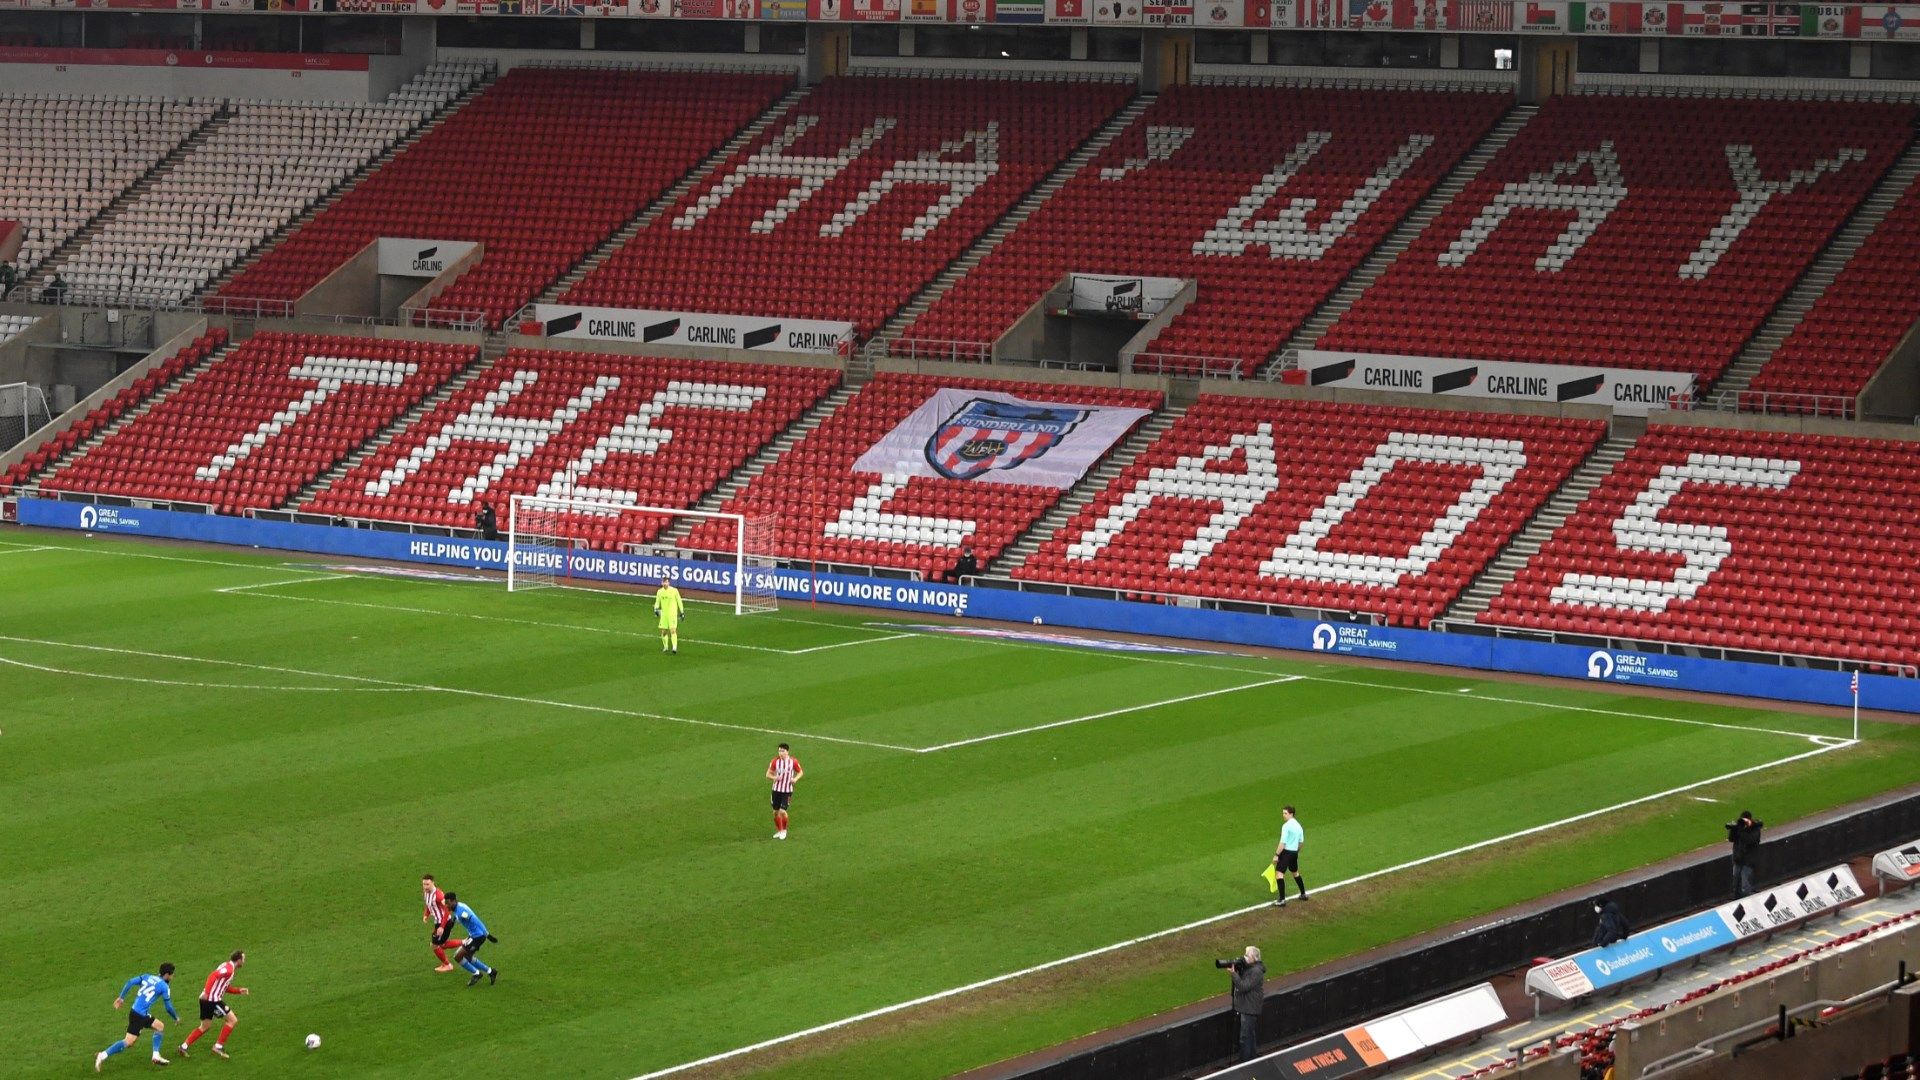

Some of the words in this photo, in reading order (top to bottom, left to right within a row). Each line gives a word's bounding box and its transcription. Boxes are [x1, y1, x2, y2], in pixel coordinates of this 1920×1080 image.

[381, 3, 411, 11] BRANCH
[1809, 7, 1852, 16] DUBLIN
[1149, 14, 1188, 24] BRANCH
[1689, 26, 1736, 34] YORKIRE
[412, 259, 443, 272] CARLING
[588, 319, 636, 338] CARLING
[687, 325, 737, 345] CARLING
[1364, 367, 1423, 389] CARLING
[1487, 374, 1548, 398] CARLING
[956, 416, 1061, 434] SUNDERLAND
[98, 508, 119, 518] GREAT
[98, 516, 118, 525] ANNUAL
[119, 518, 140, 527] SAVINGS
[410, 541, 470, 561] HELPING
[473, 546, 502, 563] YOU
[566, 555, 606, 574] YOUR
[608, 559, 680, 581] BUSINESS
[682, 566, 731, 586] GOALS
[755, 573, 810, 594] SAVING
[813, 579, 844, 597] YOU
[847, 582, 893, 602] MORE
[896, 587, 919, 604] ON
[922, 591, 968, 609] MORE
[1338, 626, 1368, 639] GREAT
[1338, 637, 1367, 647] ANNUAL
[1368, 639, 1397, 650] SAVINGS
[1616, 654, 1647, 666] GREAT
[1615, 664, 1646, 675] ANNUAL
[1647, 667, 1678, 678] SAVINGS
[1830, 884, 1857, 904] CARLING
[1799, 896, 1828, 915] CARLING
[1767, 906, 1796, 925] CARLING
[1735, 917, 1764, 936] CARLING
[1546, 961, 1578, 979] WARNING
